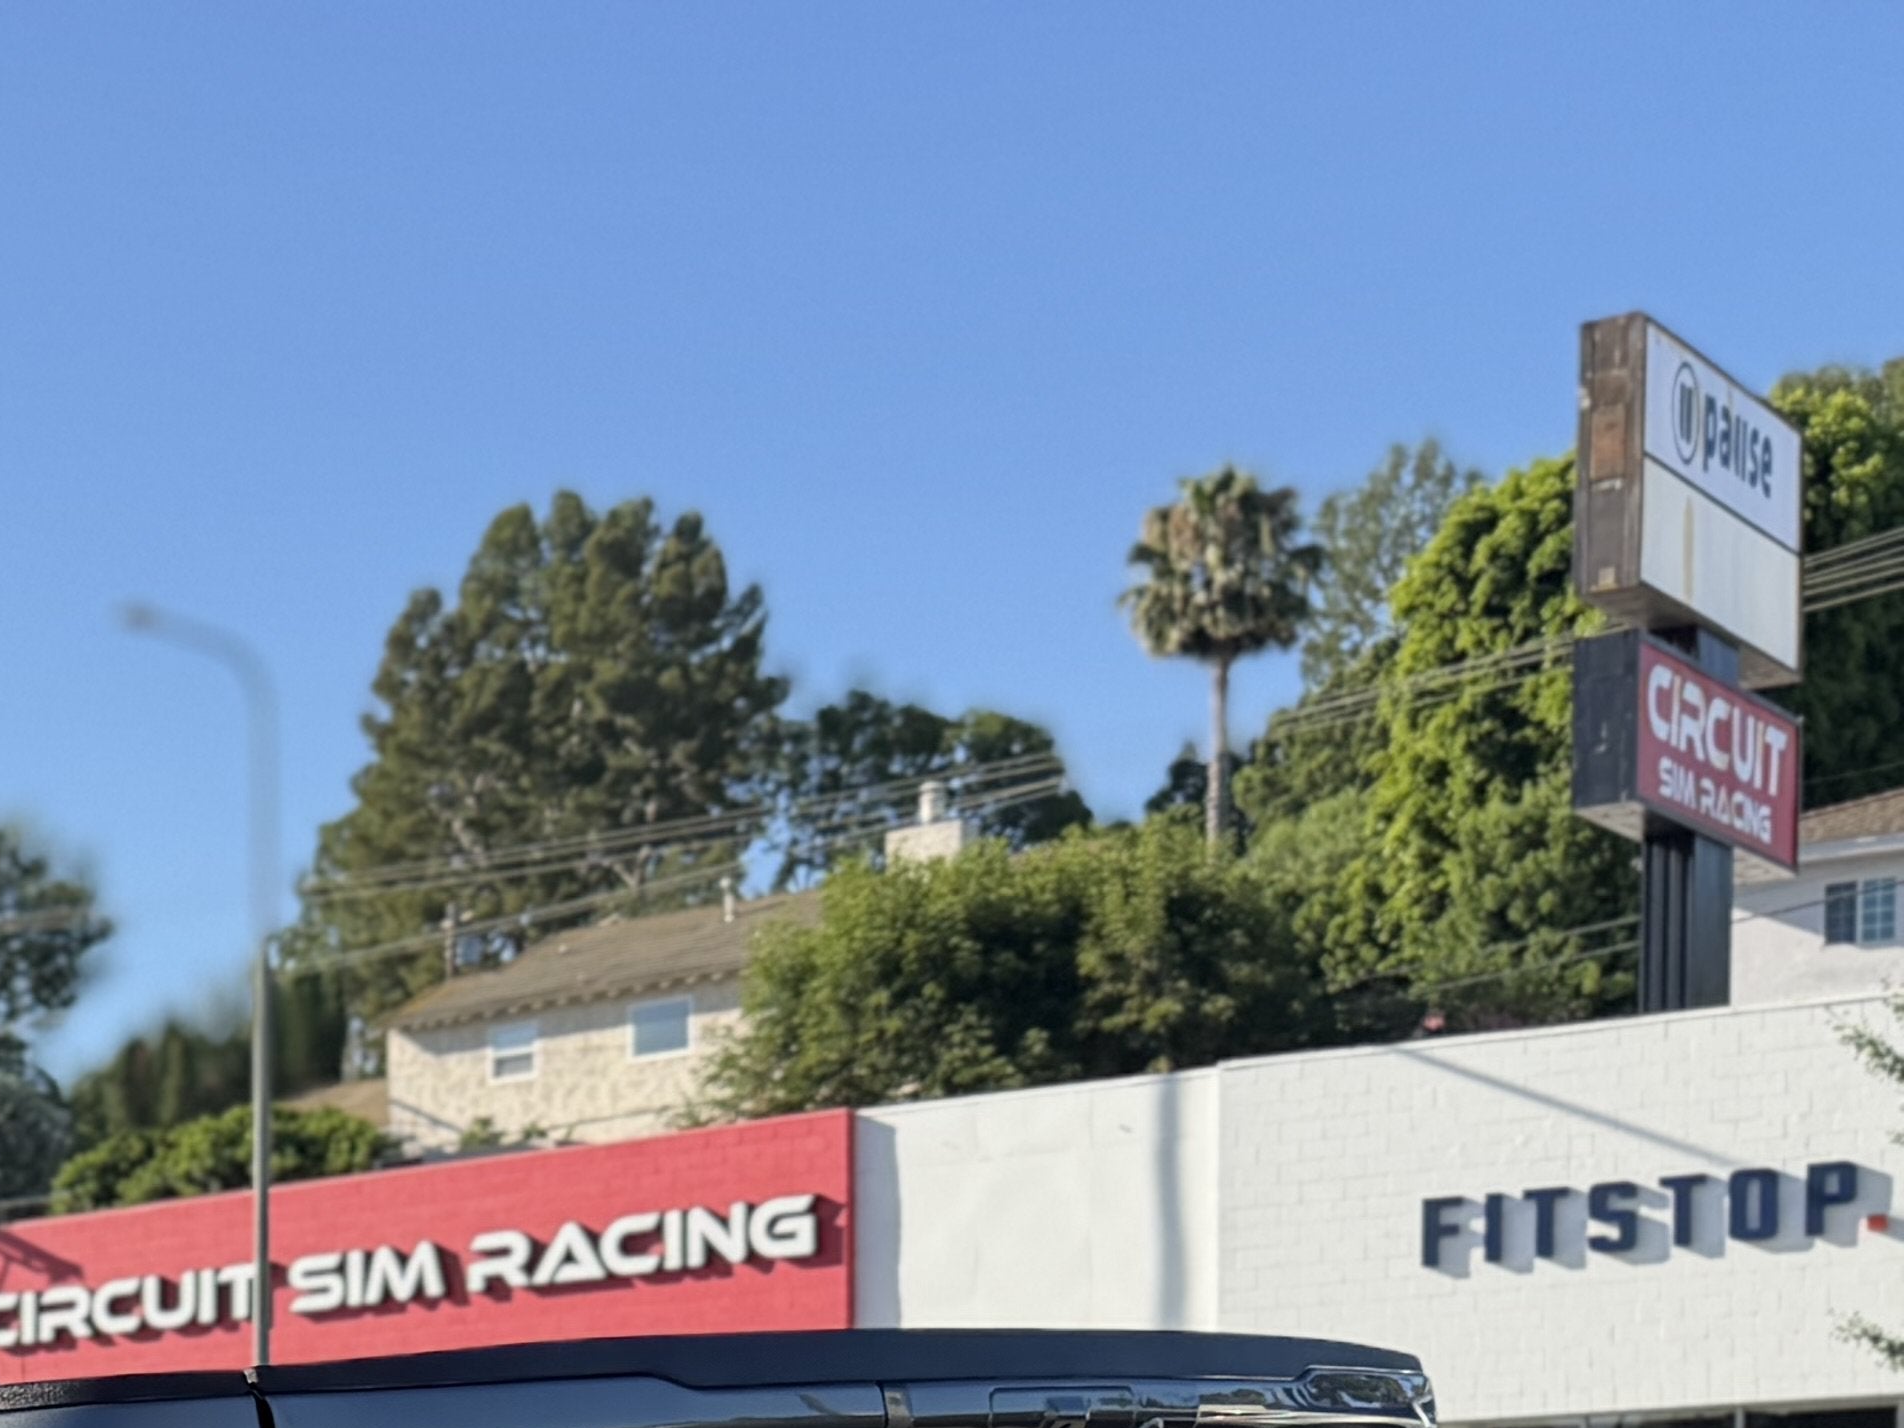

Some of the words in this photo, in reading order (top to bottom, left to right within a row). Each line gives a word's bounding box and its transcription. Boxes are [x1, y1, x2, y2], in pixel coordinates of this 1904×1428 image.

[1647, 663, 1789, 797] CIRCUIT
[1658, 756, 1696, 810] SIM
[1700, 777, 1773, 845] RACING
[288, 1240, 445, 1314] SIM
[467, 1194, 817, 1293] RACING
